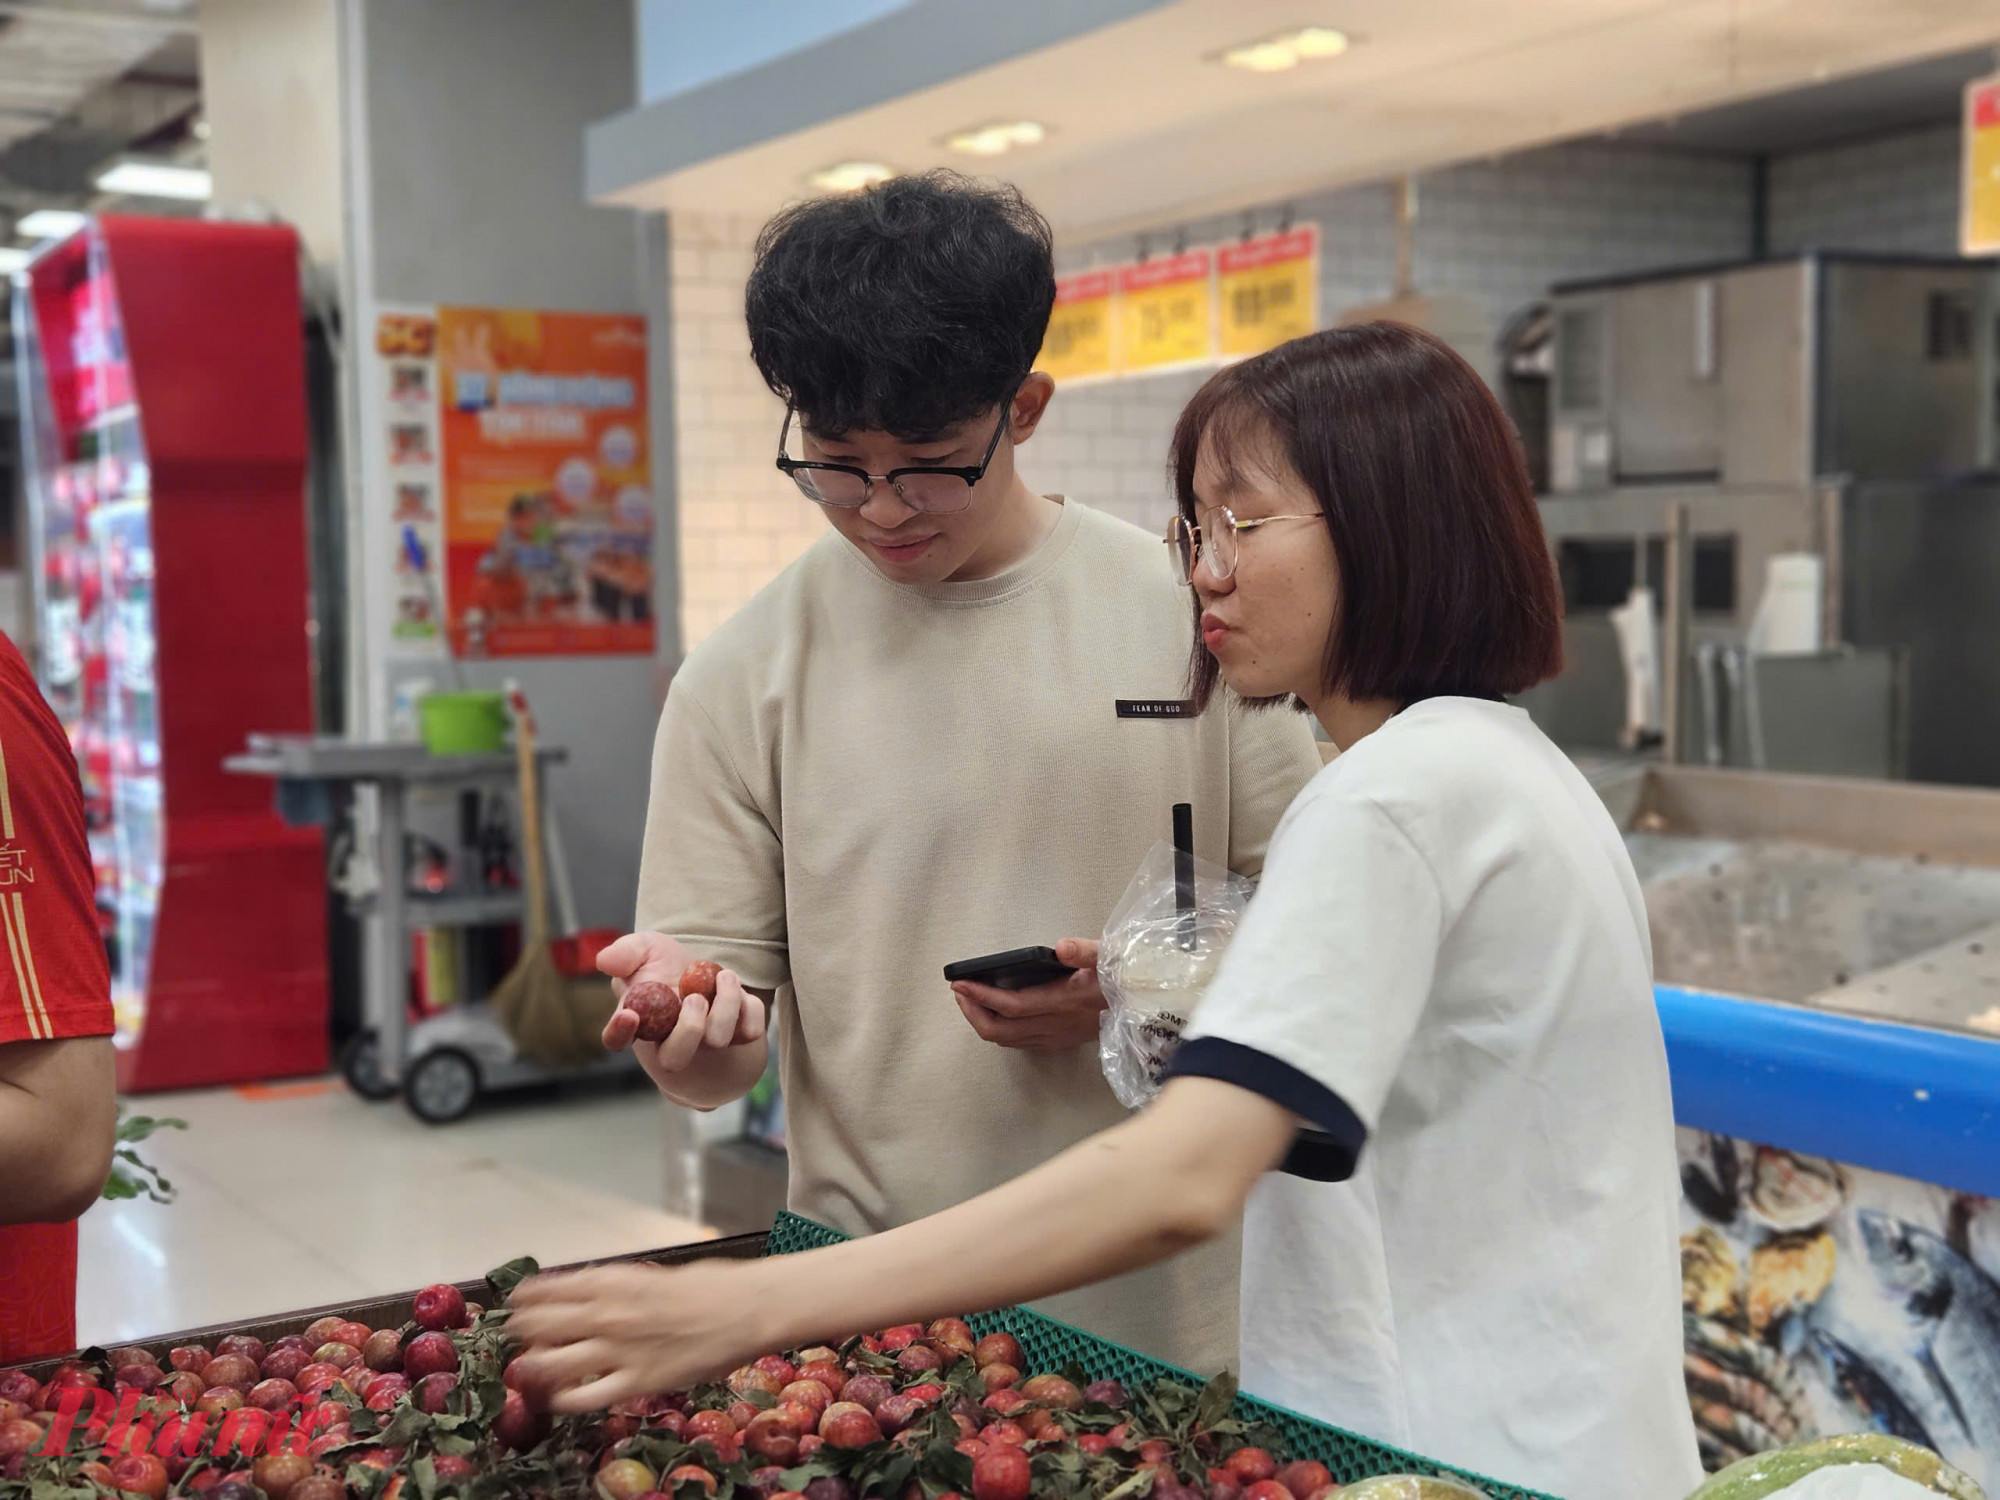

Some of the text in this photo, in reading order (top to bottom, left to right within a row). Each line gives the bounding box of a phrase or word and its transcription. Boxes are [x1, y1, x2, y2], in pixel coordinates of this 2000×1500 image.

[1132, 704, 1180, 712] FEAR OF GOD
[0, 867, 35, 885] UN
